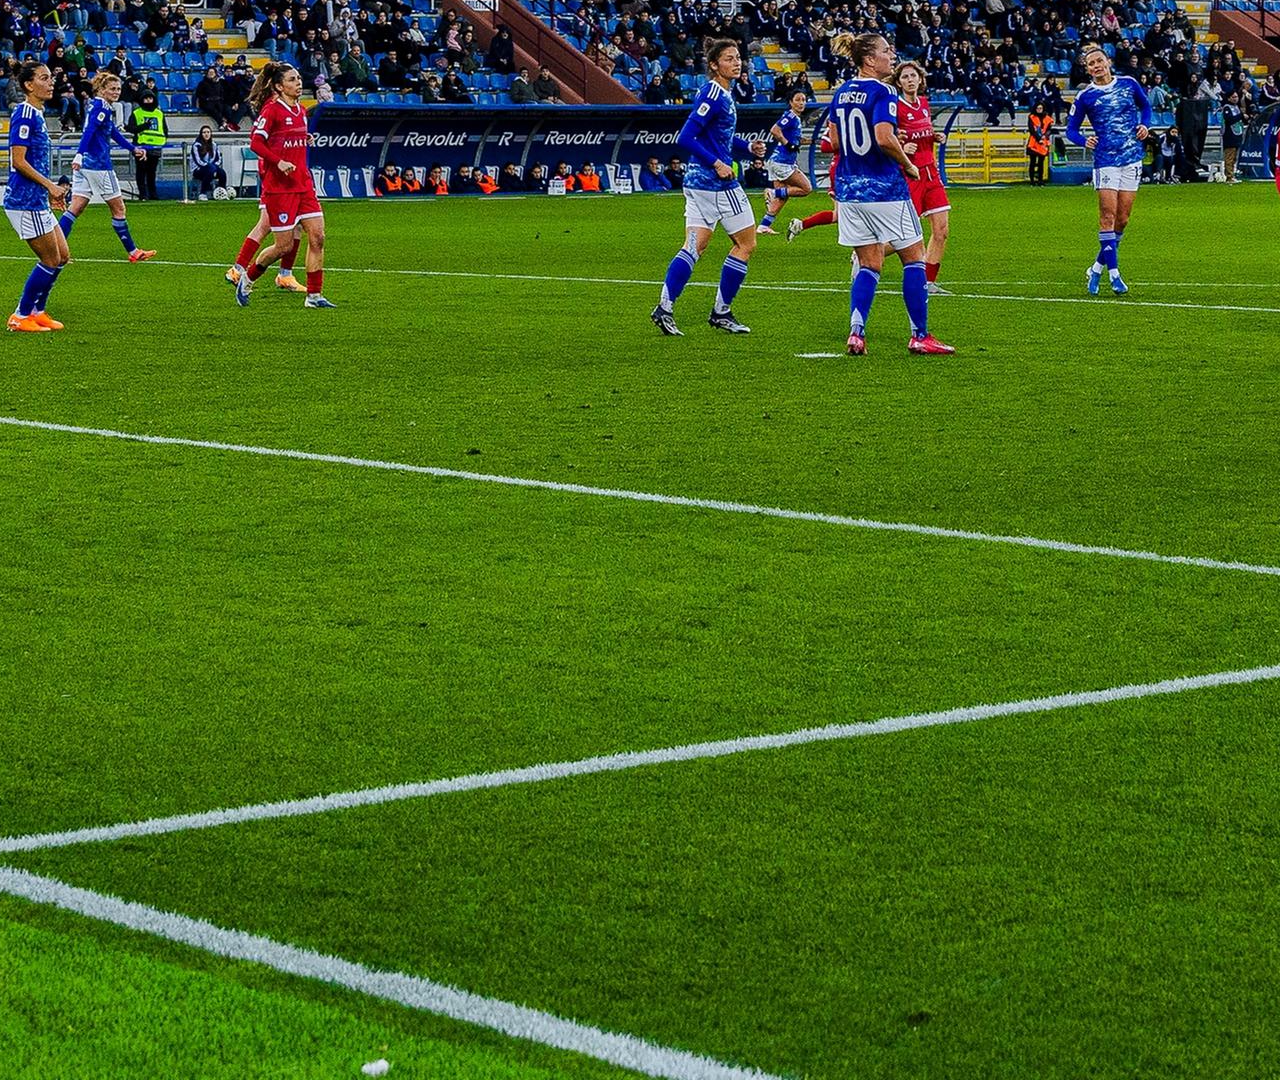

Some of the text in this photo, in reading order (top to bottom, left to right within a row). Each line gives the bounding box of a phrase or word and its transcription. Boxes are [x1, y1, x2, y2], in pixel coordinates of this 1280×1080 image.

[404, 131, 467, 147] Revolut
[498, 131, 514, 146] R
[544, 130, 605, 145] Revolut
[634, 130, 678, 145] Revol
[836, 107, 872, 156] 10
